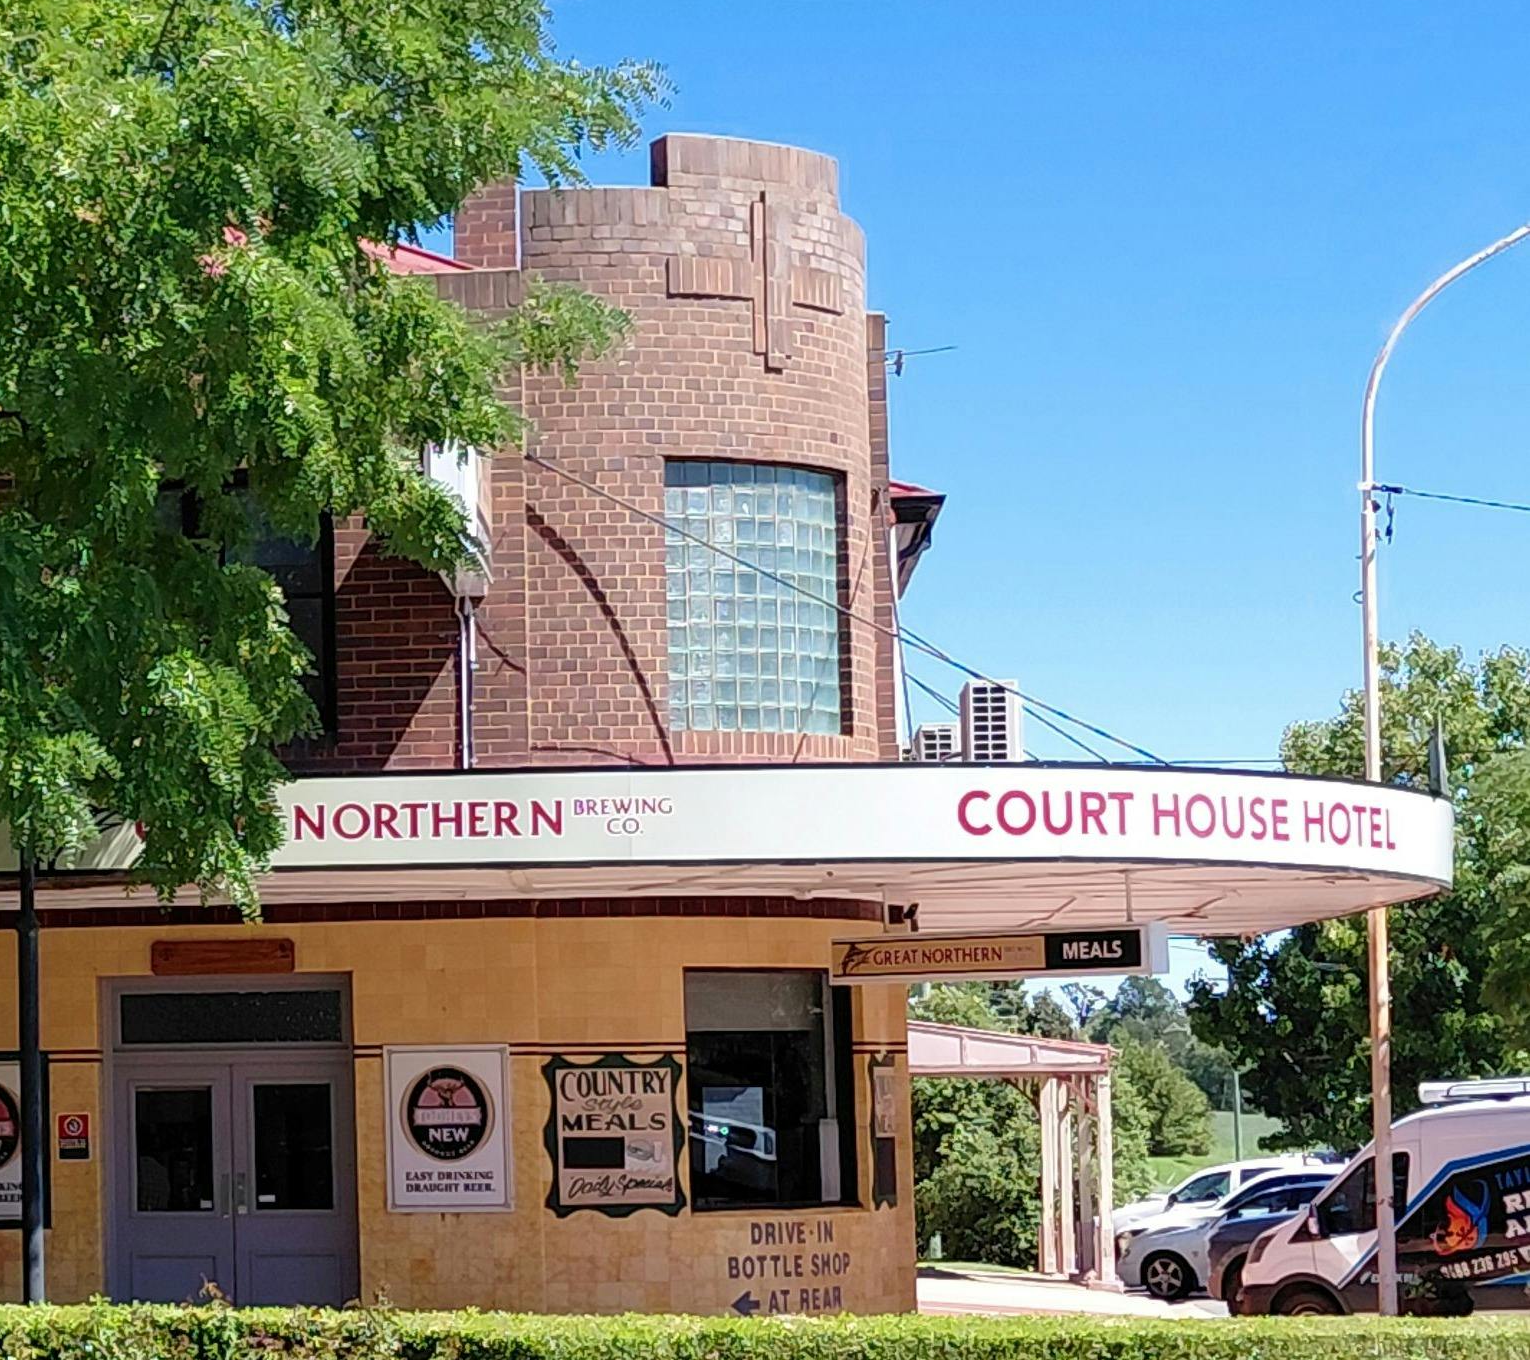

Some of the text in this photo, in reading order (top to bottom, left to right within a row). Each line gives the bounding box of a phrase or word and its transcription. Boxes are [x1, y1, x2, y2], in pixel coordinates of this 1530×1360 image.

[293, 797, 673, 840] NORTHERN BREWING
[606, 816, 644, 835] CO.
[957, 789, 1397, 851] COURT HOUSE HOTEL
[872, 948, 919, 966] GREAT
[920, 945, 1003, 965] NORTHERN
[1062, 939, 1123, 960] MEALS
[560, 1070, 668, 1102] COUNTRY
[428, 1127, 469, 1142] NEW
[562, 1113, 666, 1131] MEALS
[406, 1171, 494, 1181] EASY DRINKING
[406, 1183, 459, 1192] DRAUGHT
[727, 1252, 851, 1279] BOTTLE SHOP
[768, 1286, 843, 1313] AT REAR
